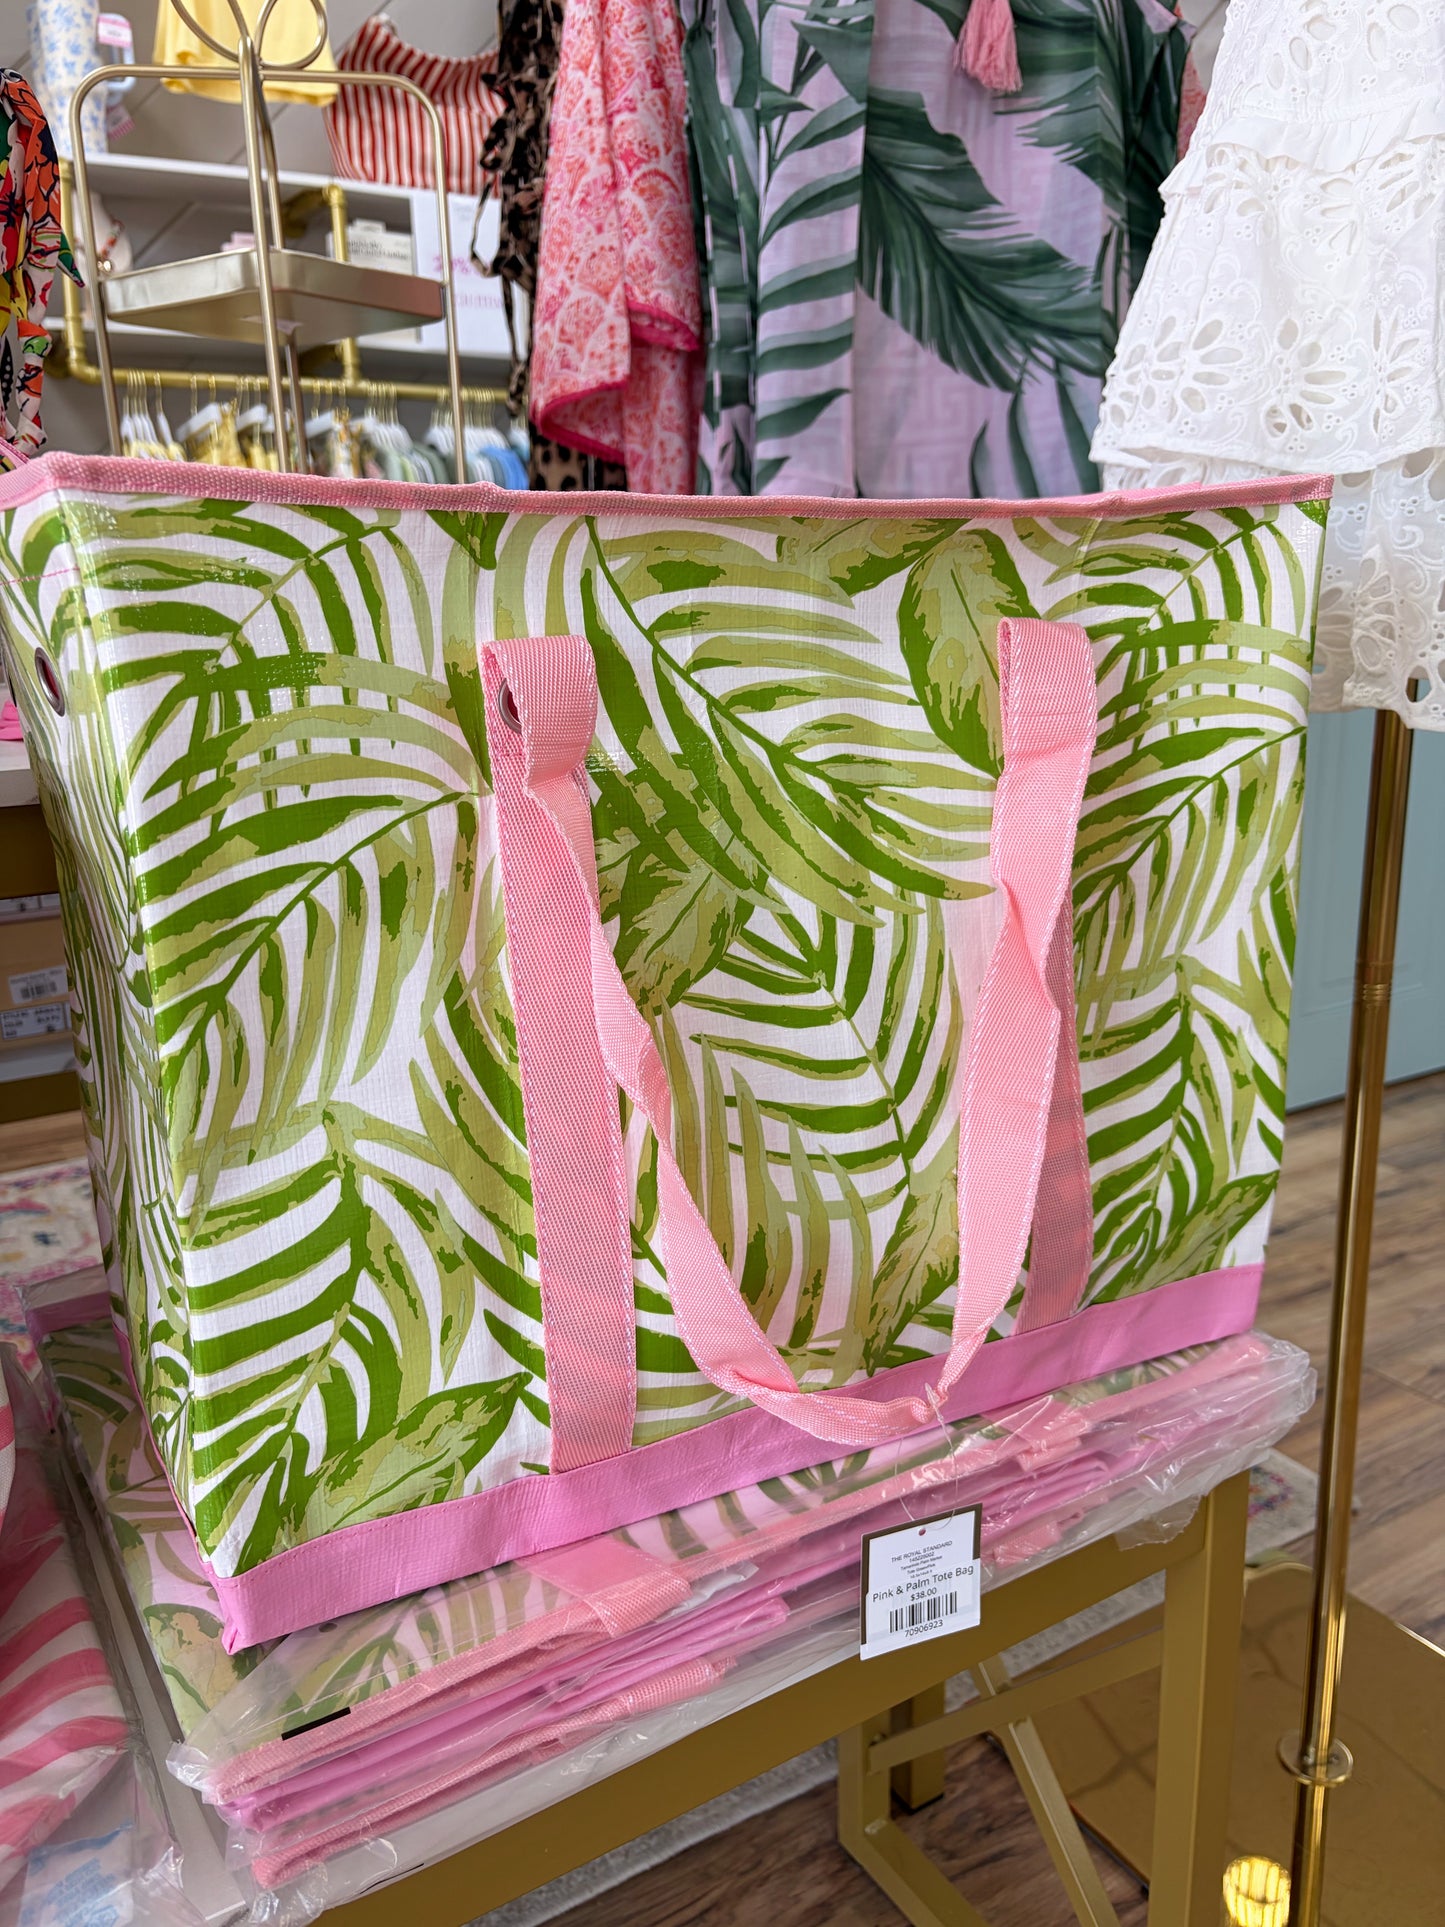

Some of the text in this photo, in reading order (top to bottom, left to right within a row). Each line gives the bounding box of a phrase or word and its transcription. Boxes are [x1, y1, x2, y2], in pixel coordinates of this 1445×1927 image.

[891, 1540, 953, 1563] THE ROYAL STANDARD
[873, 1588, 894, 1602] Pink
[895, 1585, 904, 1595] &
[906, 1578, 930, 1592] Palm
[932, 1571, 953, 1584] Tote
[955, 1565, 975, 1577] Bag
[910, 1587, 938, 1602] $38.00
[904, 1619, 944, 1638] 70906923
